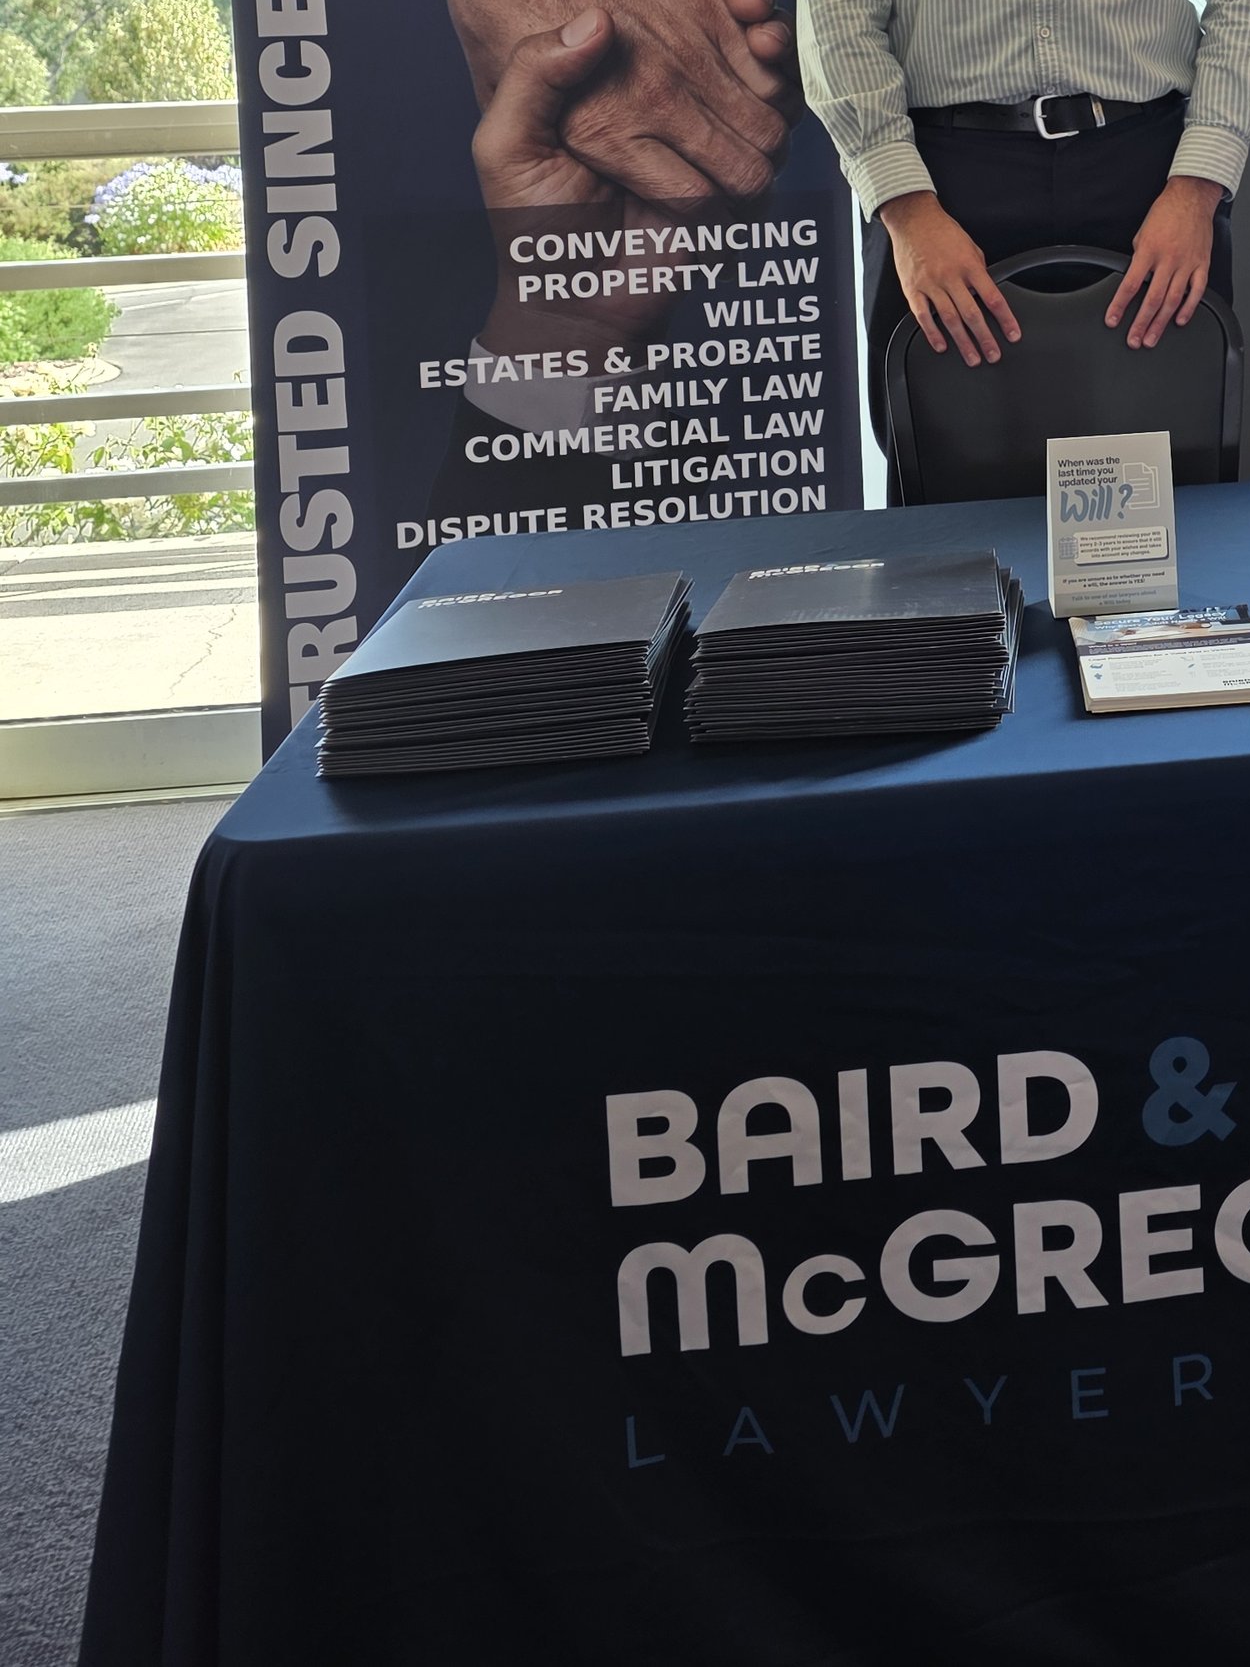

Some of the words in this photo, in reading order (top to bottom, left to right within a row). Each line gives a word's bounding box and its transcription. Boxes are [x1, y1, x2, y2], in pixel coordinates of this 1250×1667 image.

[509, 219, 818, 264] CONVEYANCING
[518, 264, 723, 303] PROPERTY
[738, 257, 819, 288] LAW
[703, 296, 820, 328] WILLS
[419, 350, 589, 389] ESTATES
[604, 347, 632, 374] &
[647, 334, 822, 371] PROBATE
[594, 379, 728, 414] FAMILY
[742, 371, 823, 403] LAW
[464, 417, 729, 464] COMMERCIAL
[744, 410, 824, 441] LAW
[611, 447, 826, 490] LITIGATION
[1058, 459, 1084, 468] When
[1086, 458, 1104, 466] was
[1106, 456, 1120, 464] the
[1058, 469, 1074, 477] last
[1076, 468, 1095, 476] time
[1097, 467, 1113, 477] you
[1059, 477, 1096, 488] updated
[1098, 476, 1118, 487] your
[396, 507, 568, 549] DISPUTE
[583, 485, 827, 530] RESOLUTION
[1060, 485, 1113, 523] Will
[1094, 618, 1141, 626] Secure
[1179, 612, 1226, 620] Legacy
[605, 1049, 1099, 1207] BAIRD
[1141, 1036, 1238, 1146] &
